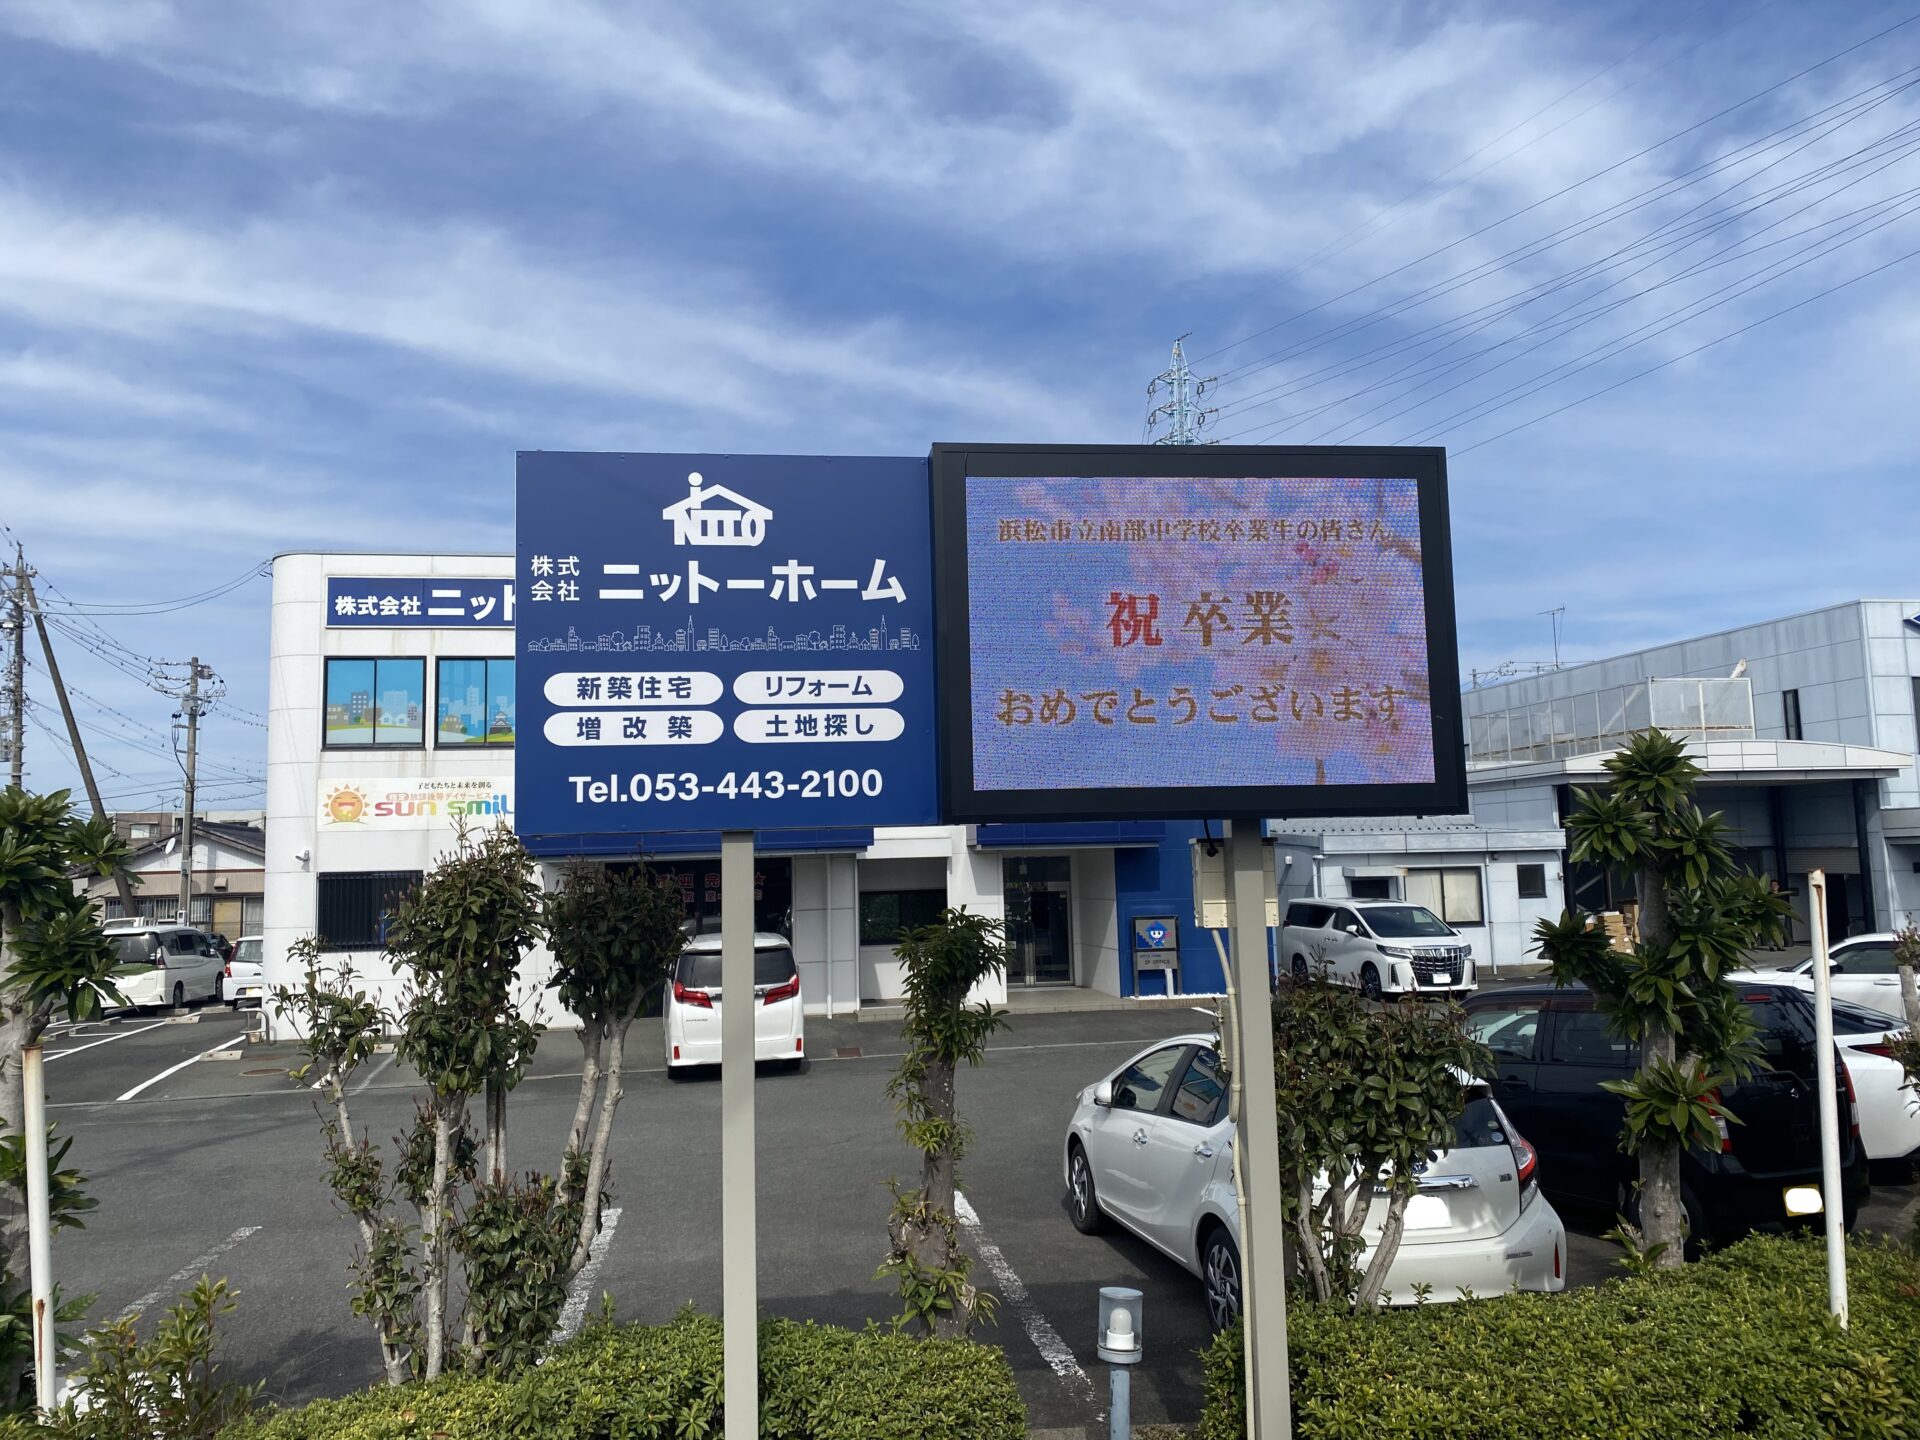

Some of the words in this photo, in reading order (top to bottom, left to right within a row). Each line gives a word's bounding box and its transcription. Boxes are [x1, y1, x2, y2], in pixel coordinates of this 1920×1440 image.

[999, 518, 1391, 543] 浜松市立南部中学校卒業生の皆さん
[599, 558, 907, 604] ニットーホーム
[1106, 592, 1163, 648] 祝
[1181, 591, 1295, 648] 卒業
[576, 675, 693, 700] 新築住宅
[765, 675, 873, 698] リフォーム
[998, 685, 1407, 728] おめでとうございます
[576, 716, 693, 740] 増改築
[765, 714, 875, 737] 土地探し
[568, 768, 883, 803] Tel.053-443-2100
[375, 801, 437, 817] sun
